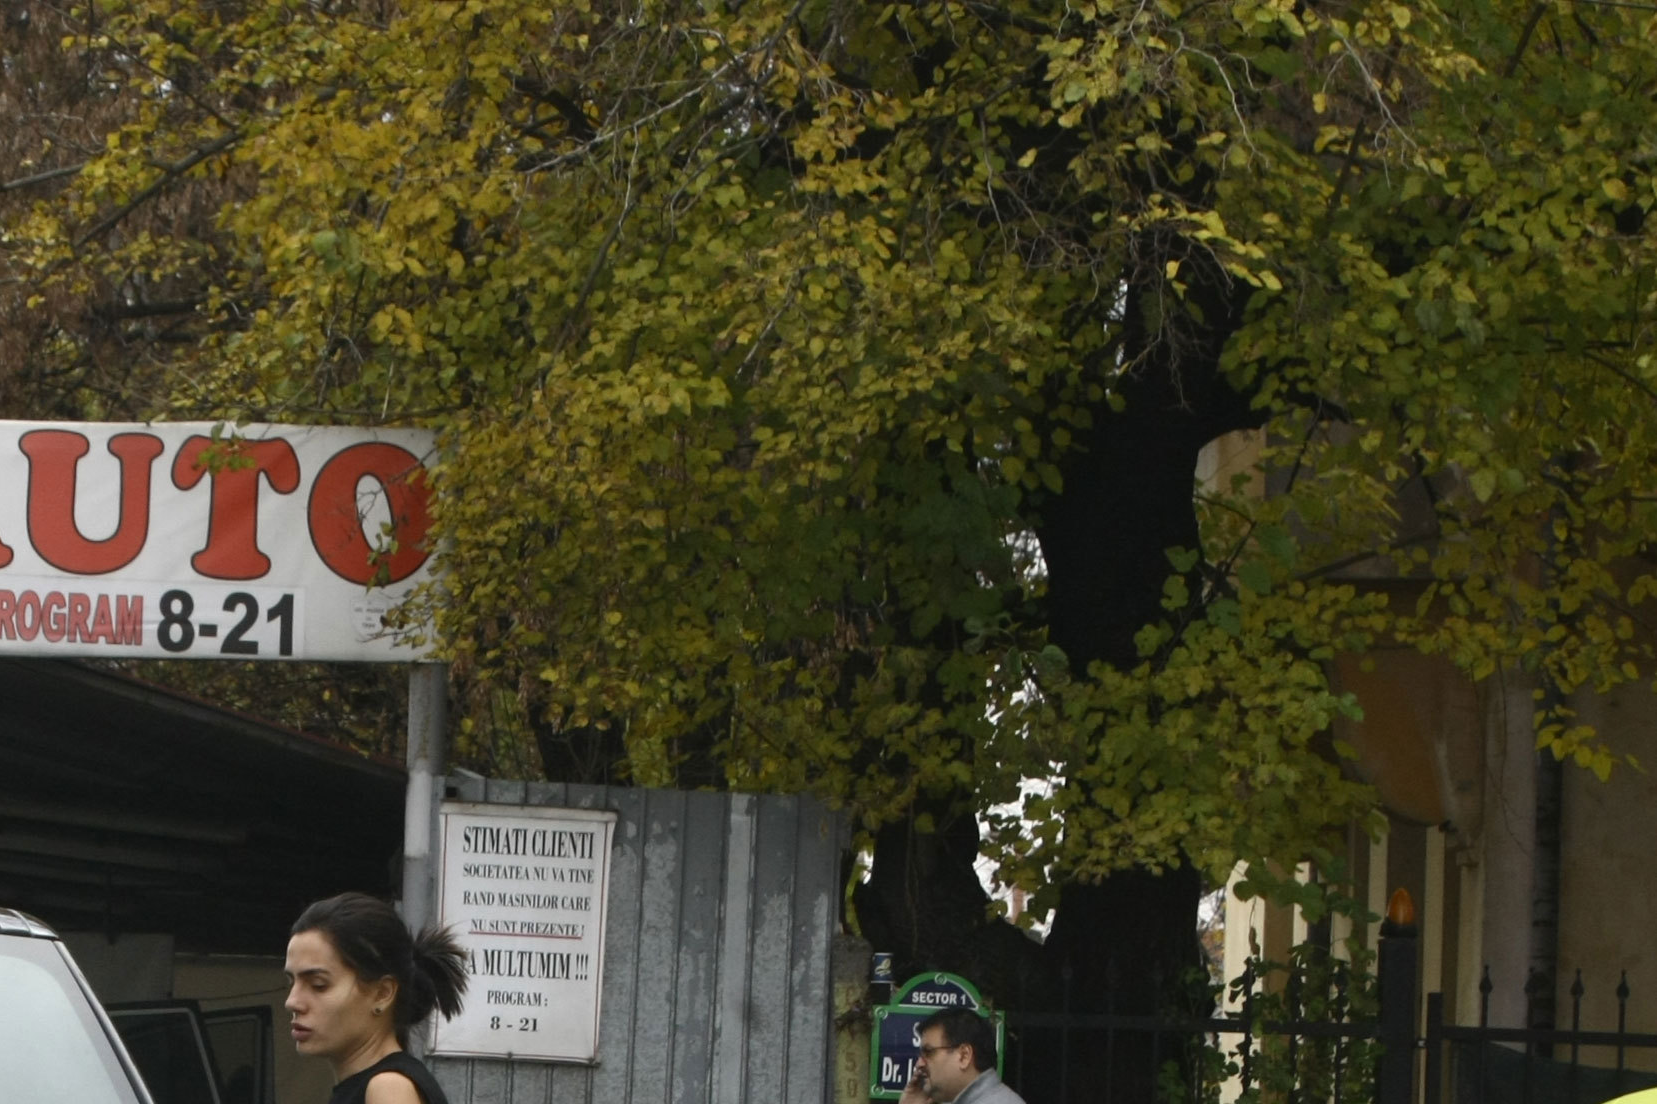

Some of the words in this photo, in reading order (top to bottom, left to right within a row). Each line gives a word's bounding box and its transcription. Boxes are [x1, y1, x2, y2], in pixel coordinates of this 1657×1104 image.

[156, 589, 296, 657] 8-21
[463, 826, 528, 856] STIMATI
[531, 829, 595, 860] CLIENTI
[462, 862, 530, 881] SOCIETATEA
[532, 866, 549, 882] NU
[552, 867, 566, 883] VA
[568, 868, 595, 884] TINE
[463, 890, 494, 906] RAND
[498, 892, 559, 910] MASINILOR
[561, 896, 591, 912] CARE
[471, 919, 488, 931] NU
[489, 920, 519, 933] SUNT
[520, 921, 580, 937] PREZENTE
[482, 949, 572, 981] MULTUMIM
[575, 954, 589, 981] !!!
[487, 990, 542, 1007] PROGRAM
[912, 991, 957, 1005] SECTOR
[960, 994, 966, 1006] 1
[490, 1016, 500, 1031] 8
[518, 1017, 539, 1032] 21
[881, 1056, 902, 1083] Dr.
